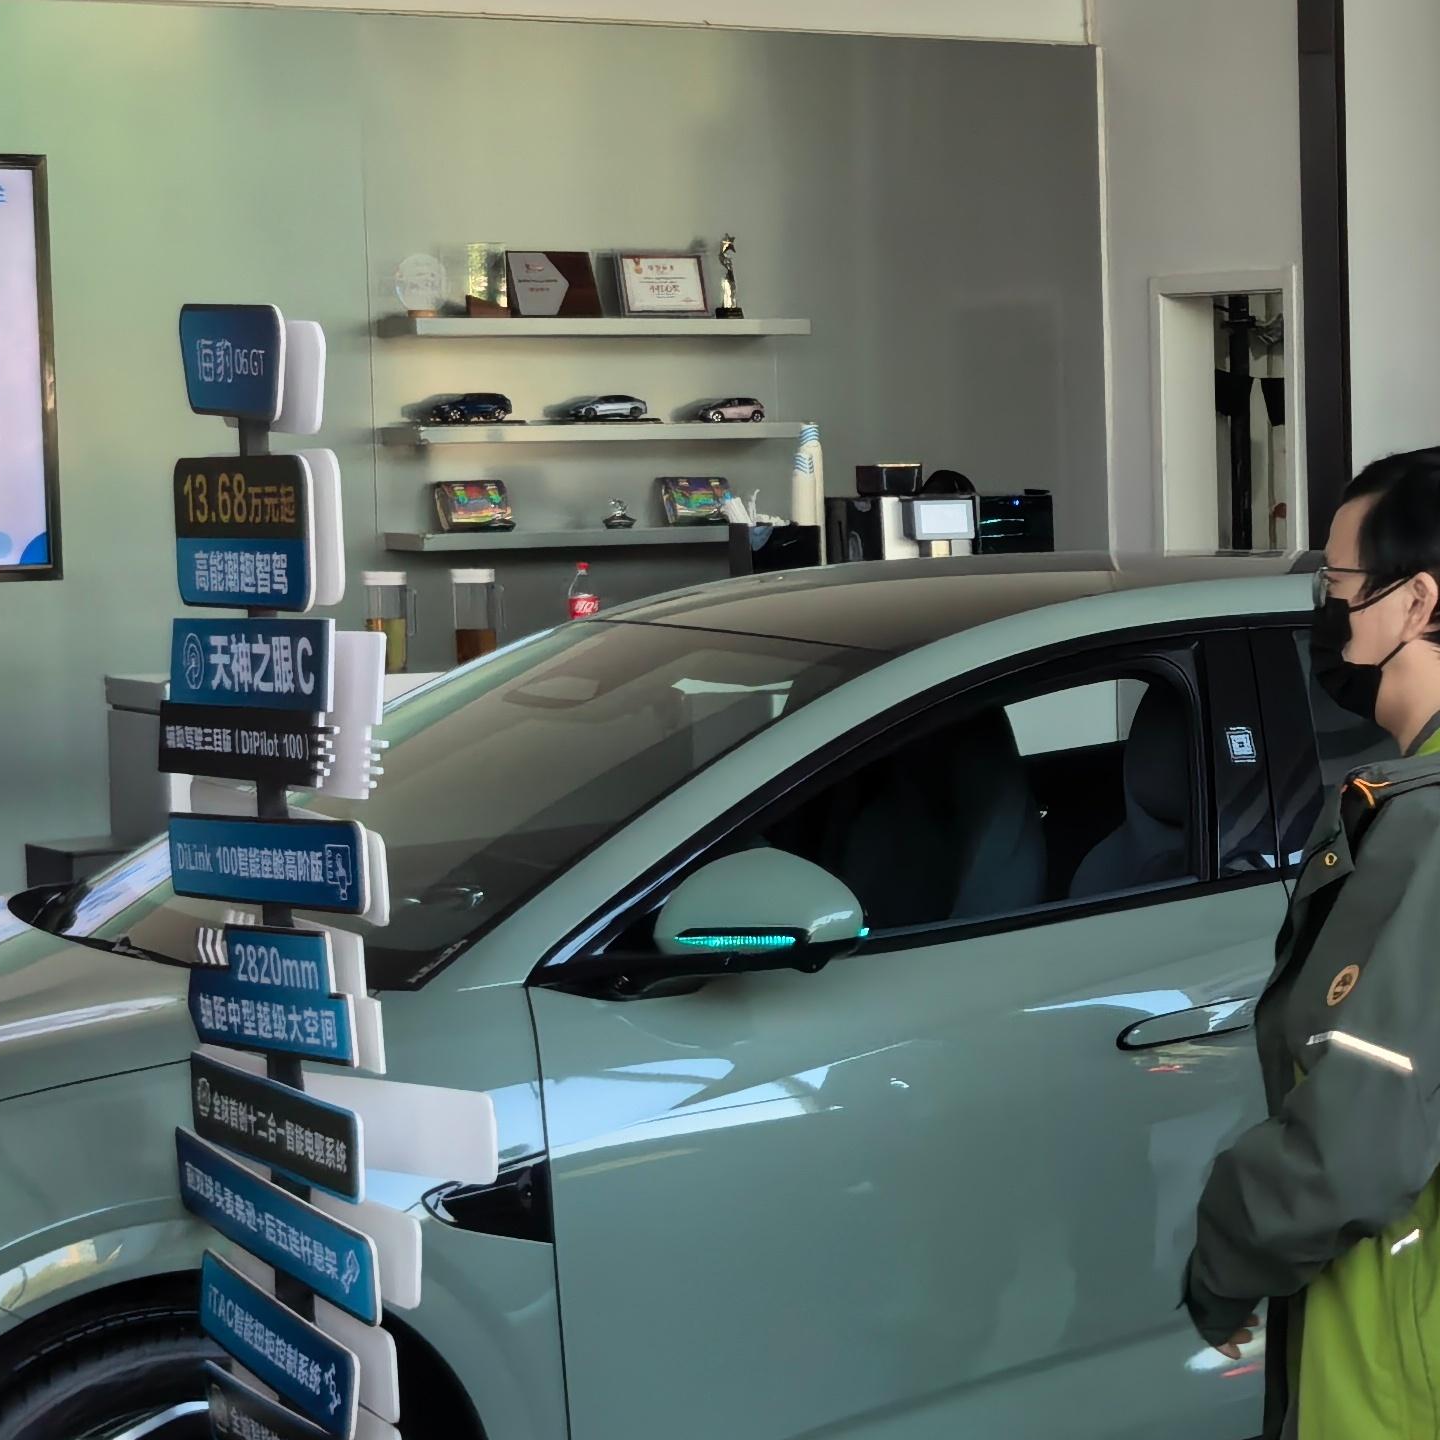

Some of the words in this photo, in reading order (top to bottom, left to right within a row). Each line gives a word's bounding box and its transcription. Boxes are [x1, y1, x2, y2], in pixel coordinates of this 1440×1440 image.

[183, 472, 297, 524] 13.68万元起
[176, 843, 214, 873] DiLink
[234, 943, 321, 990] 2820mm
